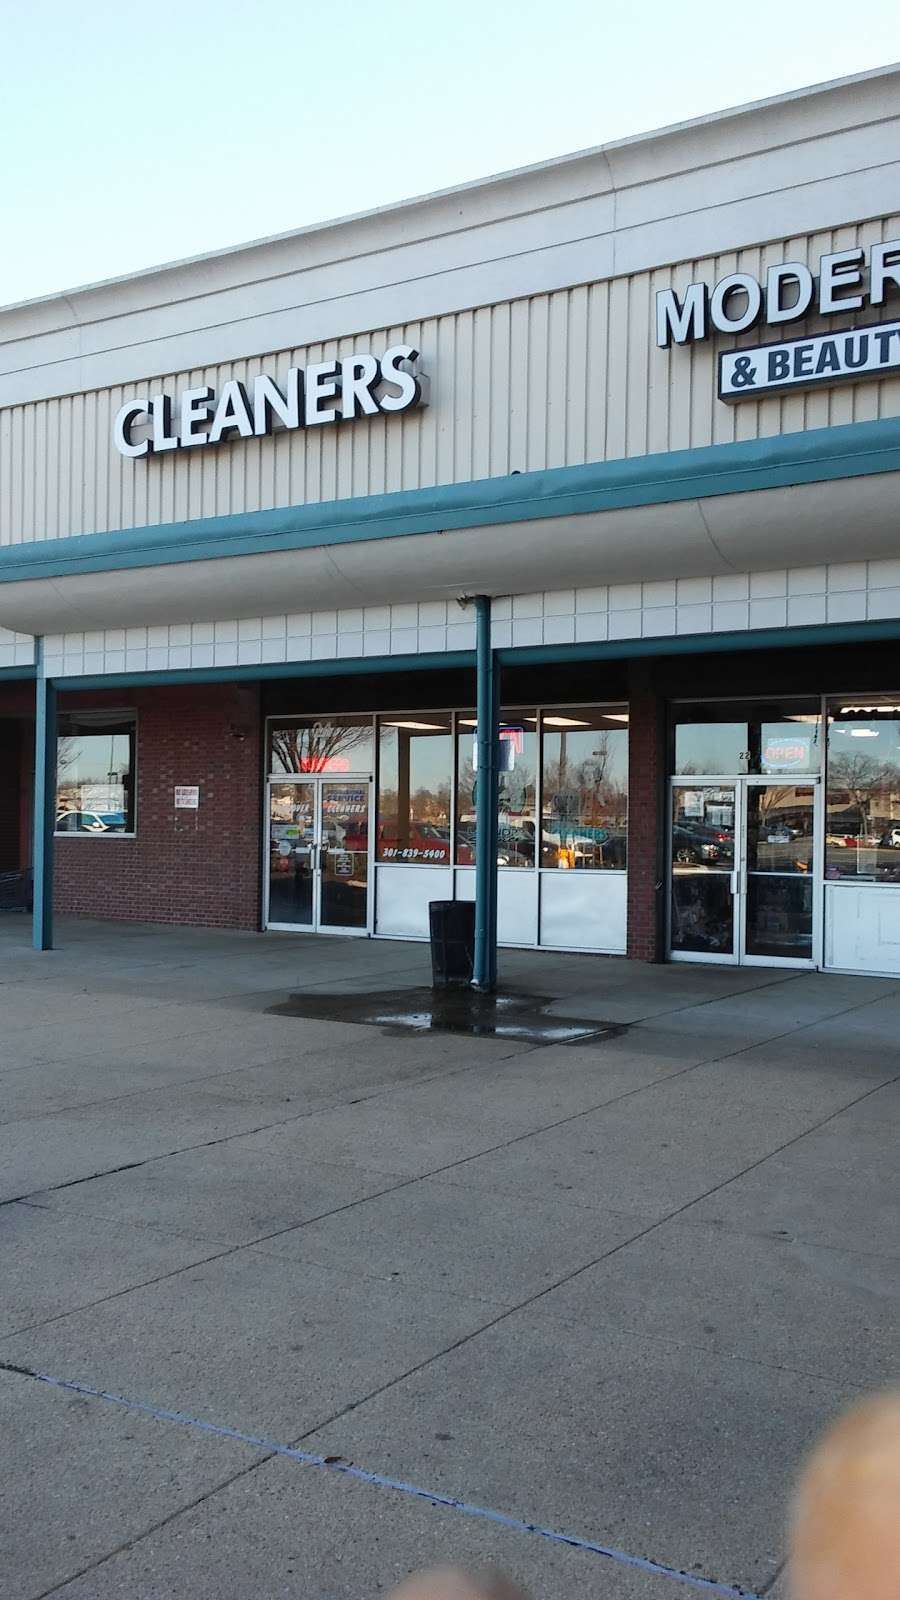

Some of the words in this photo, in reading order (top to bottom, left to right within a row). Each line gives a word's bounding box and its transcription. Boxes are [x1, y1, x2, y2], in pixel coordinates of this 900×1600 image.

[731, 356, 757, 388] &
[768, 329, 900, 383] BEAUT
[114, 344, 420, 459] CLEANERS
[738, 751, 752, 761] 22
[764, 745, 805, 760] OPEN
